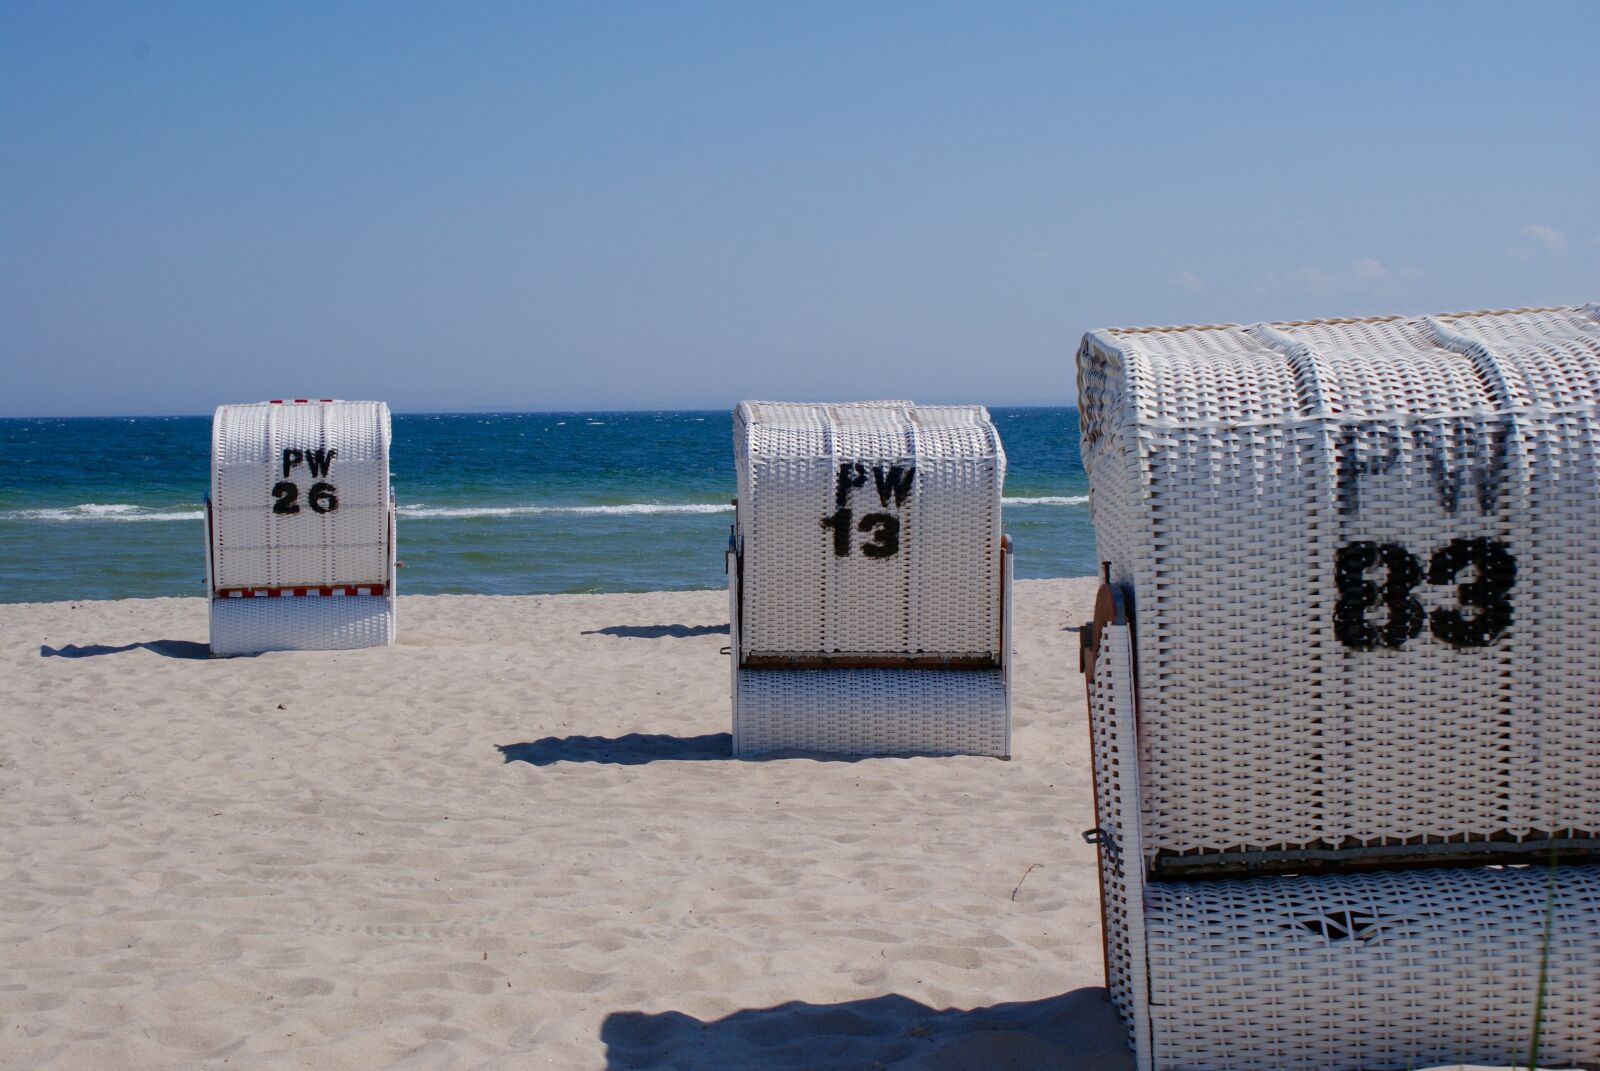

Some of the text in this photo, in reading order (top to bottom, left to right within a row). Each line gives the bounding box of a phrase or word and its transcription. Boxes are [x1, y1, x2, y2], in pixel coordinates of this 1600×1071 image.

[282, 448, 337, 479] PW
[835, 462, 917, 508] PW
[1339, 420, 1515, 516] PW
[271, 481, 339, 514] 26
[820, 508, 900, 559] 13
[1333, 536, 1518, 649] 83
